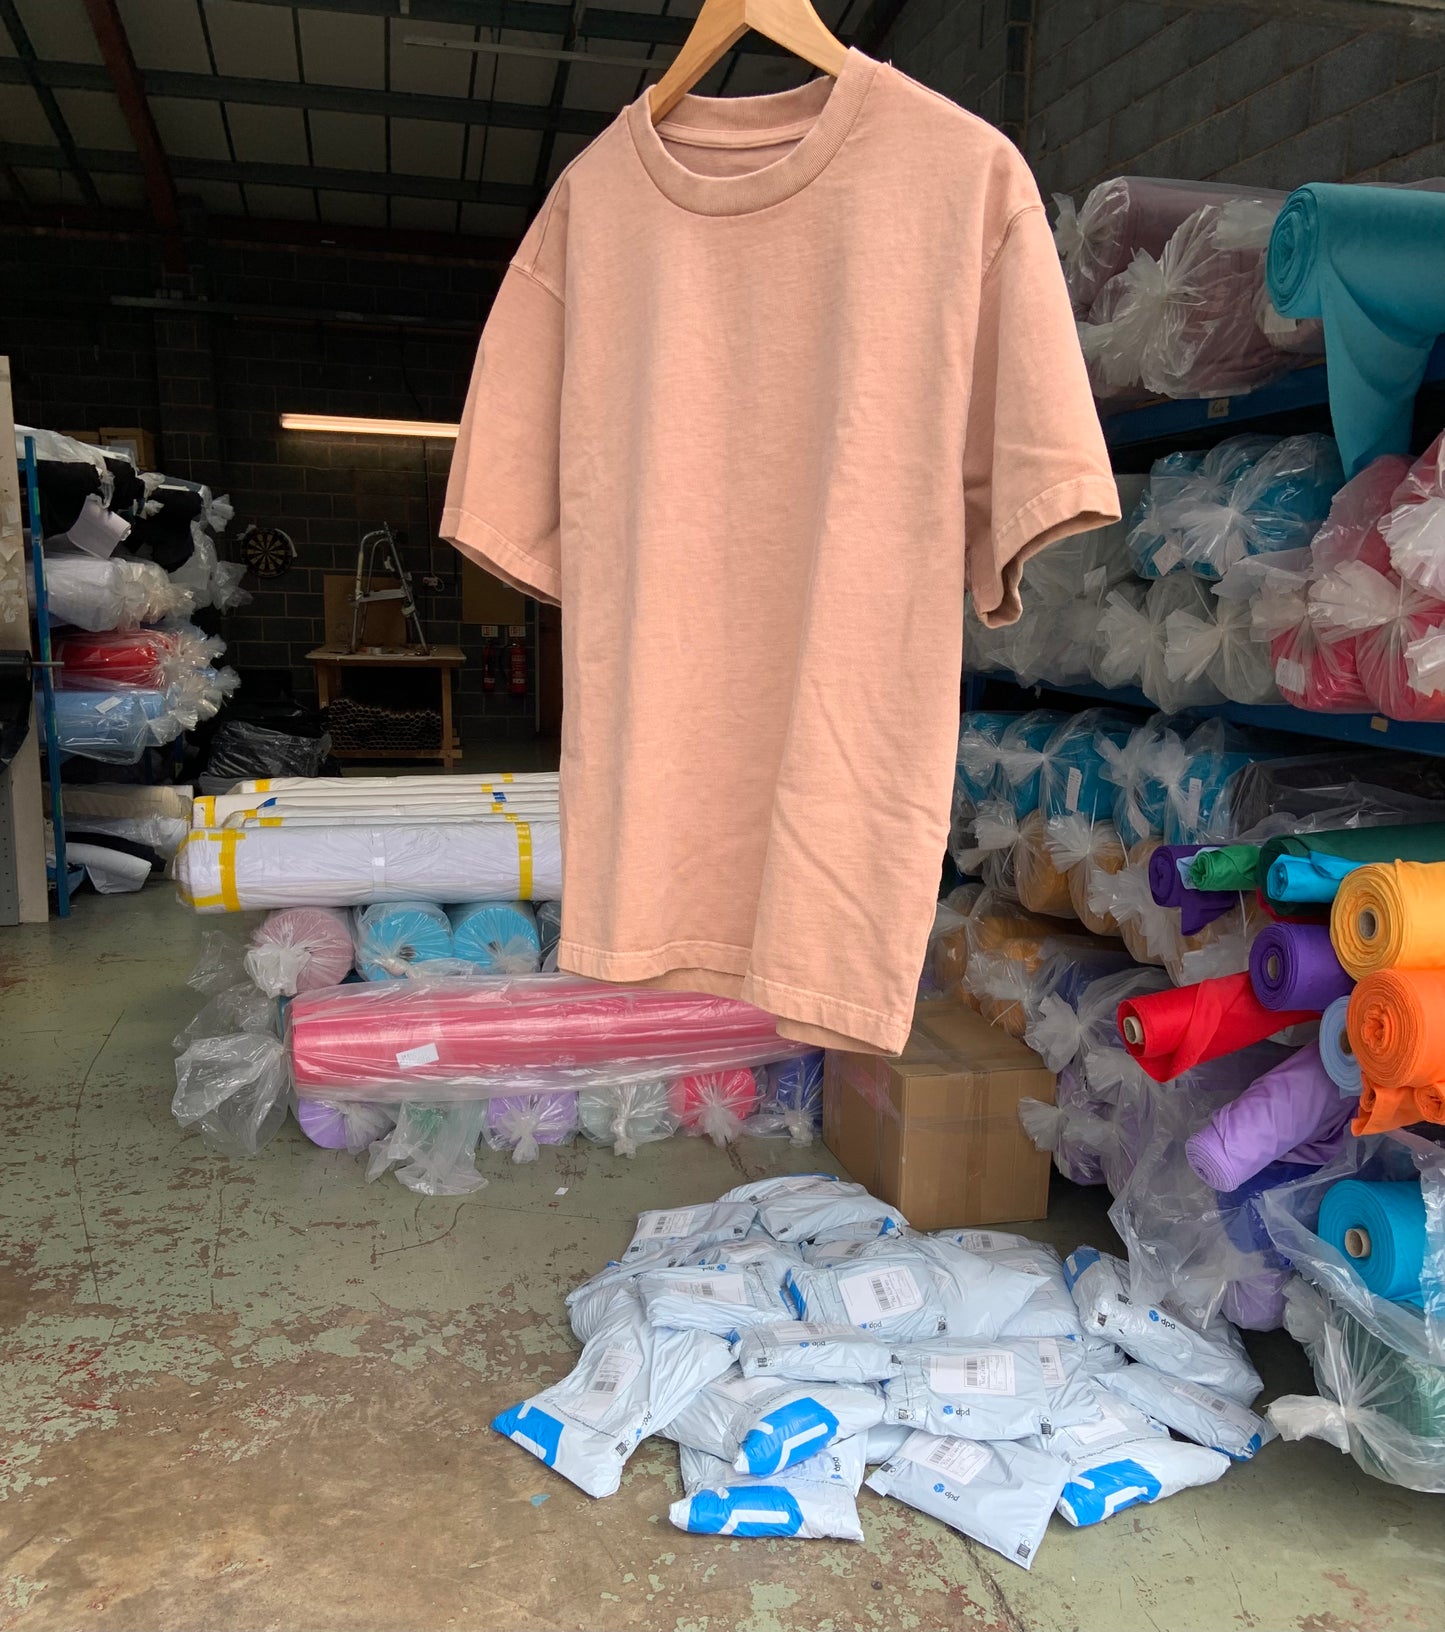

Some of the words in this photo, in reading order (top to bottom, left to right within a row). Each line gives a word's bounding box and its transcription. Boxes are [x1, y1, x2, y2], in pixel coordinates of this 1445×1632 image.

[870, 1321, 882, 1331] dpd
[956, 1408, 970, 1416] dpd
[832, 1457, 841, 1471] dpd
[945, 1491, 960, 1501] dpd
